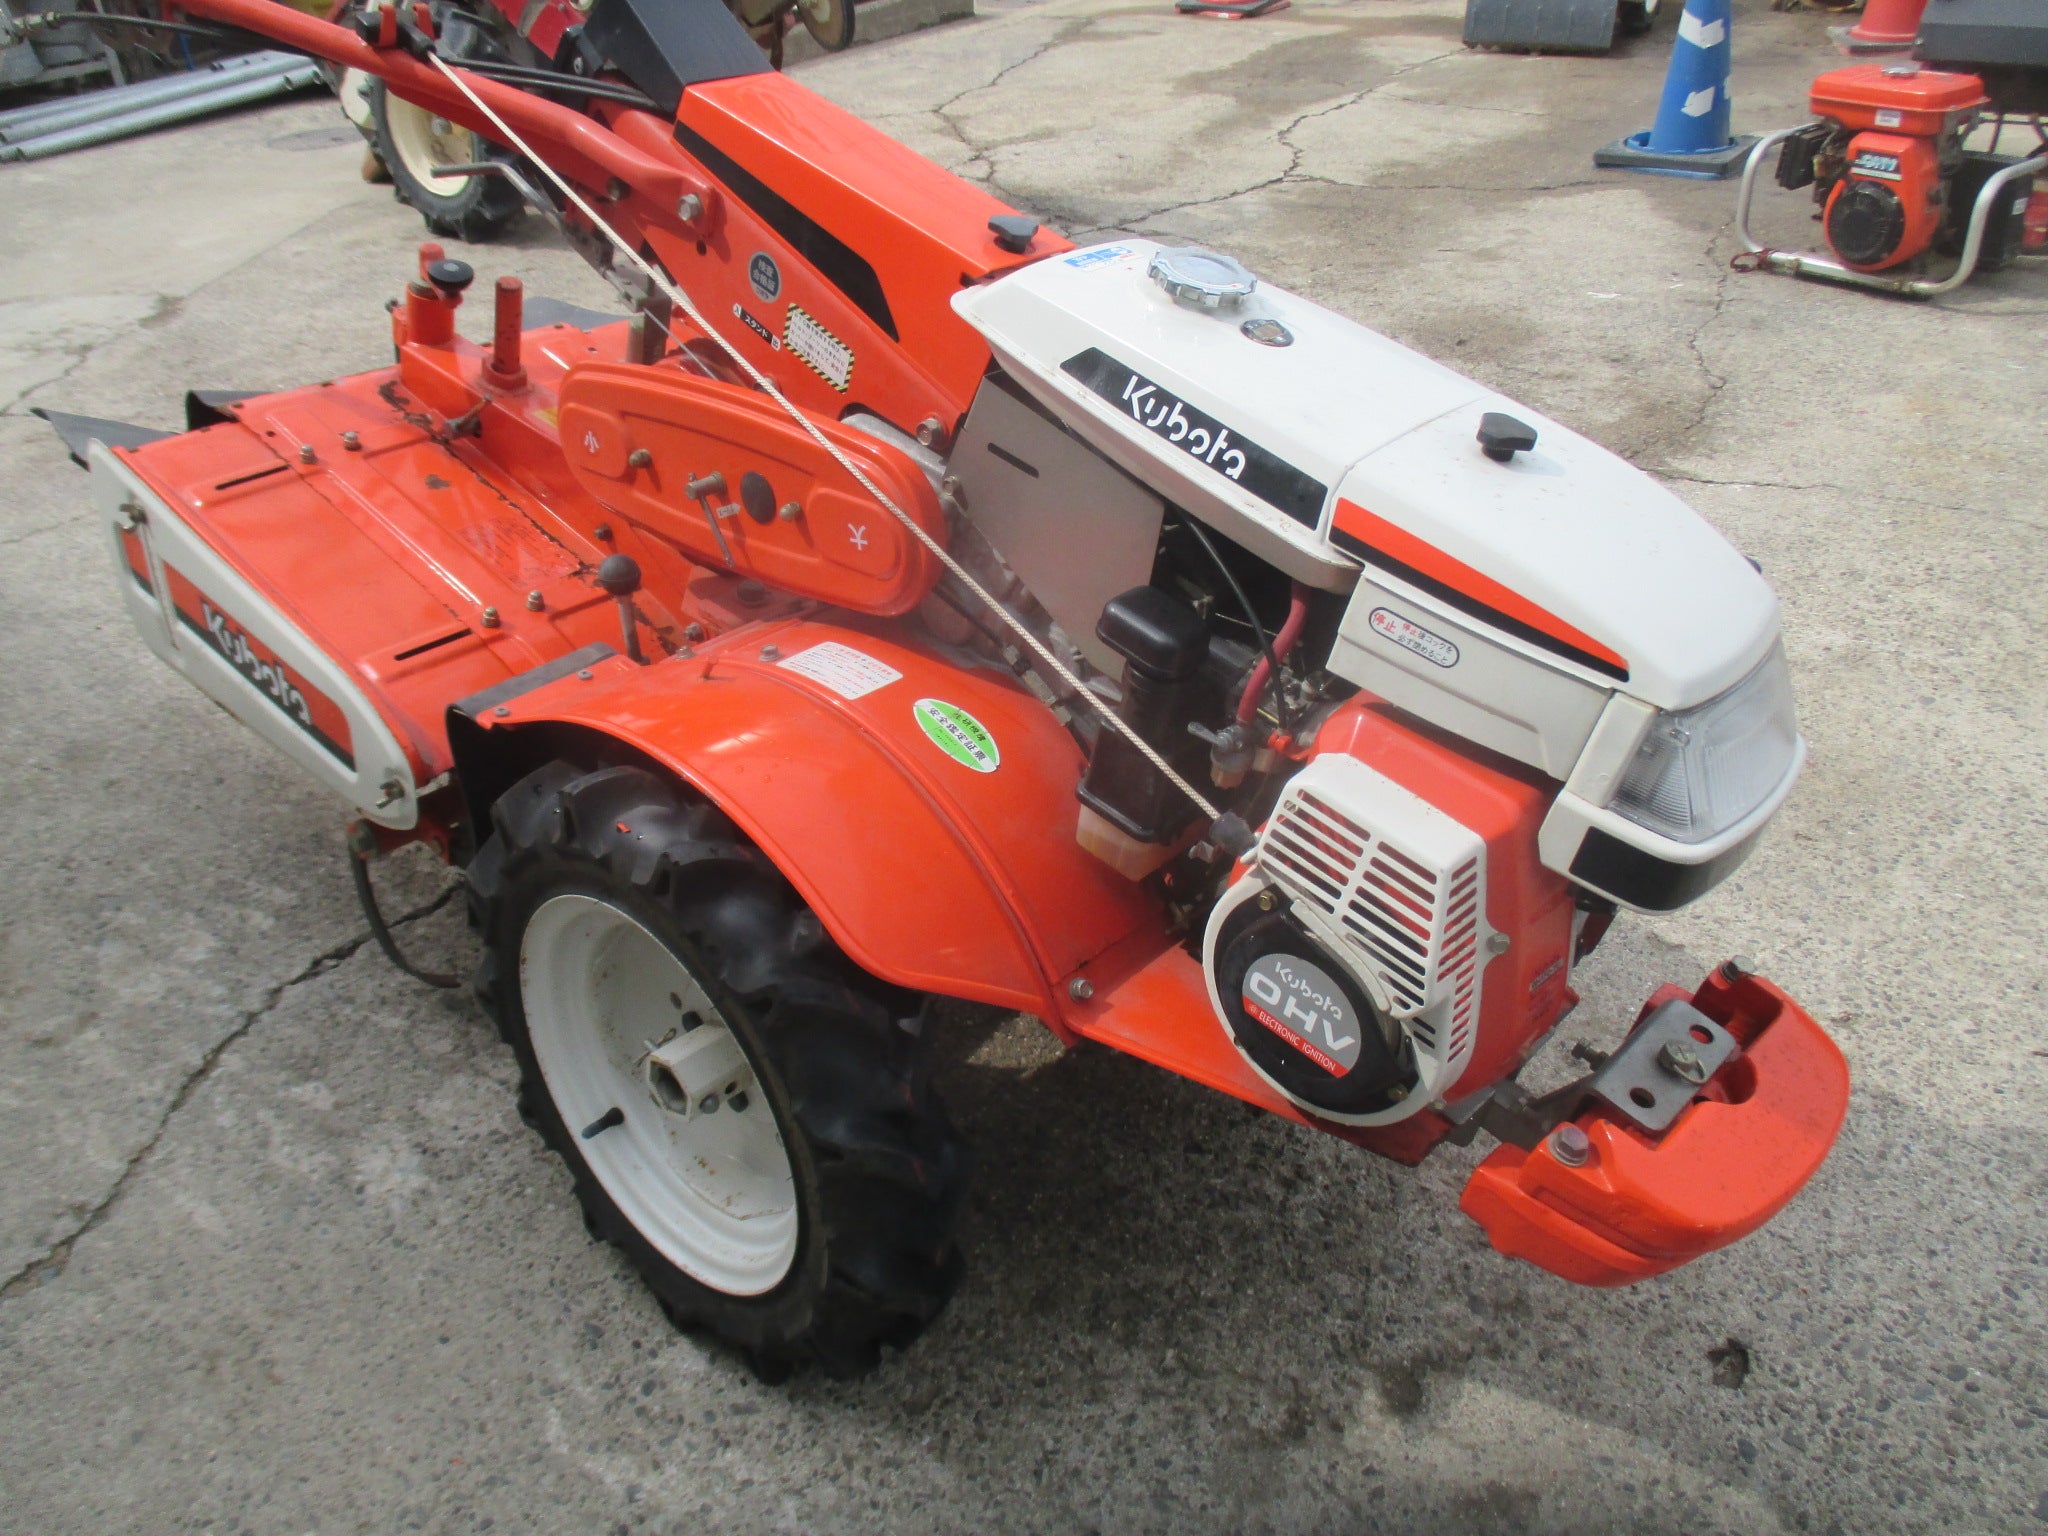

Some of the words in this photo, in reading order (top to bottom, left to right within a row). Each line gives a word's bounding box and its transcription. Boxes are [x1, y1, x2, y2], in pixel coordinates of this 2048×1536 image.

[744, 314, 769, 339] スタンド
[1122, 374, 1246, 480] Kubota
[1373, 611, 1397, 635] 停止
[202, 602, 312, 725] Kubota
[1249, 971, 1356, 1051] OHV
[1275, 961, 1342, 1021] Kubota
[1259, 1011, 1300, 1046] ELECTRONIC
[1302, 1043, 1336, 1072] IGNITION
